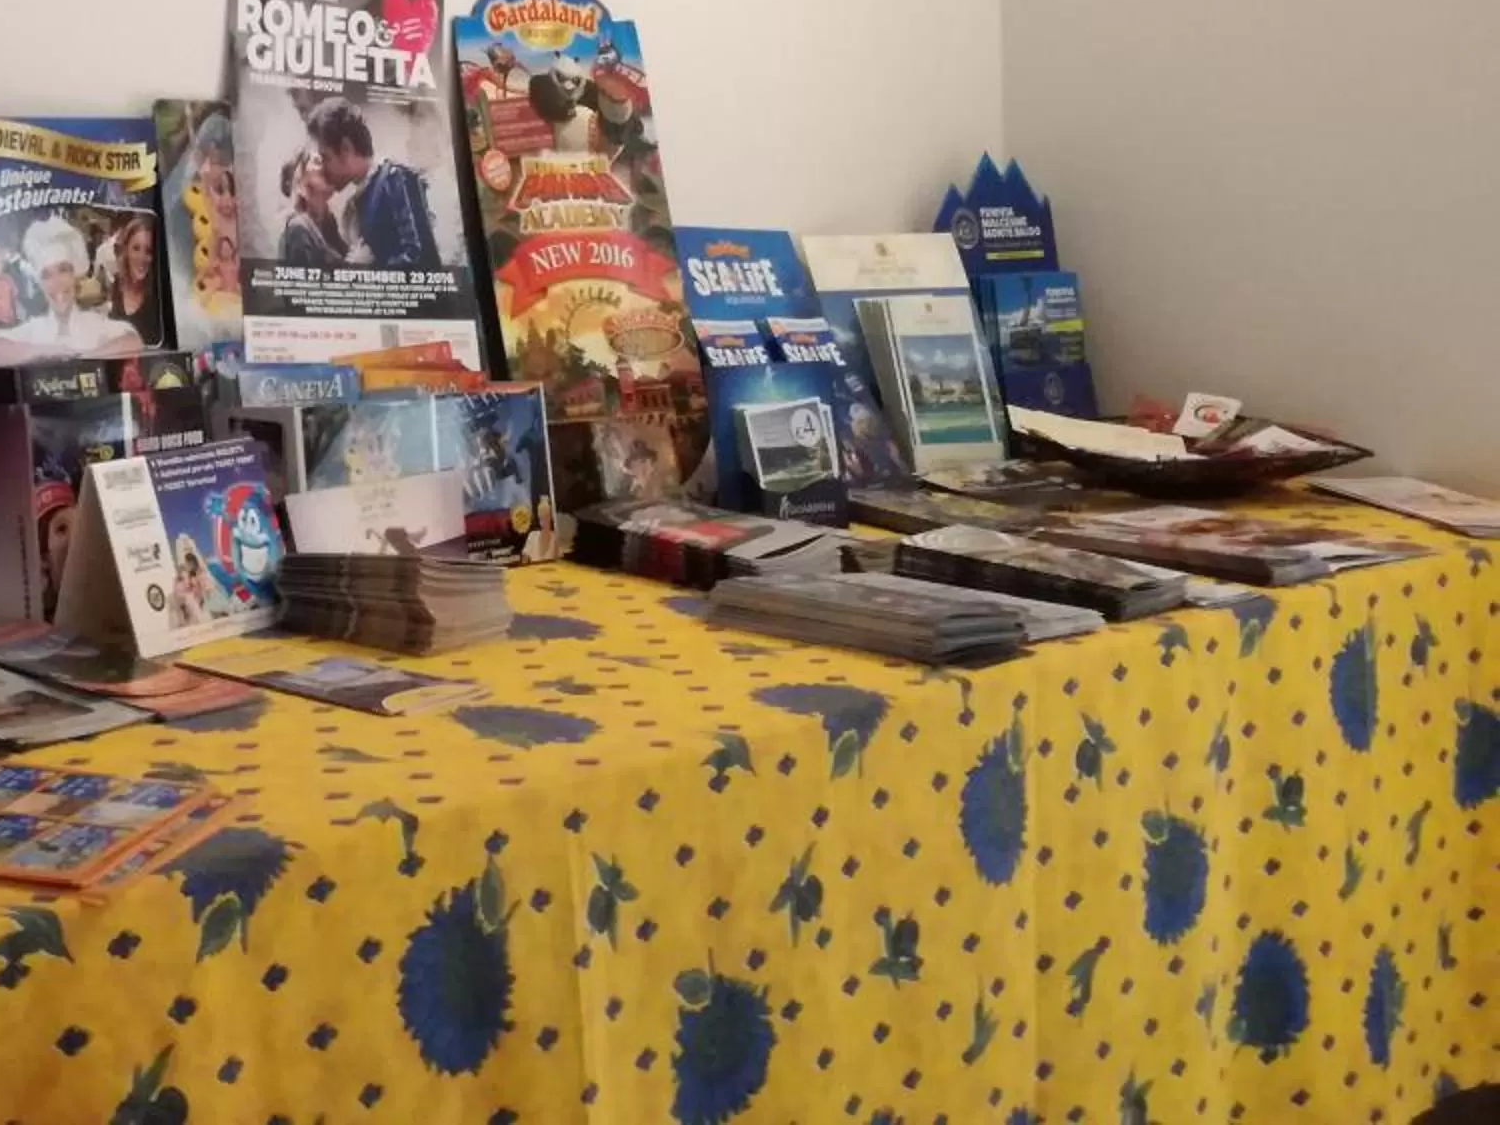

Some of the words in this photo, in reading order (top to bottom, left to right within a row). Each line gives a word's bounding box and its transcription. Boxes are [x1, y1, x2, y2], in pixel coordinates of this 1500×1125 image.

[246, 32, 437, 89] GIULIETTA
[64, 145, 102, 169] ROCK
[105, 151, 141, 171] STAR
[0, 165, 52, 188] Unique
[530, 242, 585, 274] NEW
[588, 242, 635, 269] 2016
[274, 266, 305, 282] JUNE
[307, 268, 322, 282] 27
[333, 268, 407, 284] SEPTEMBER
